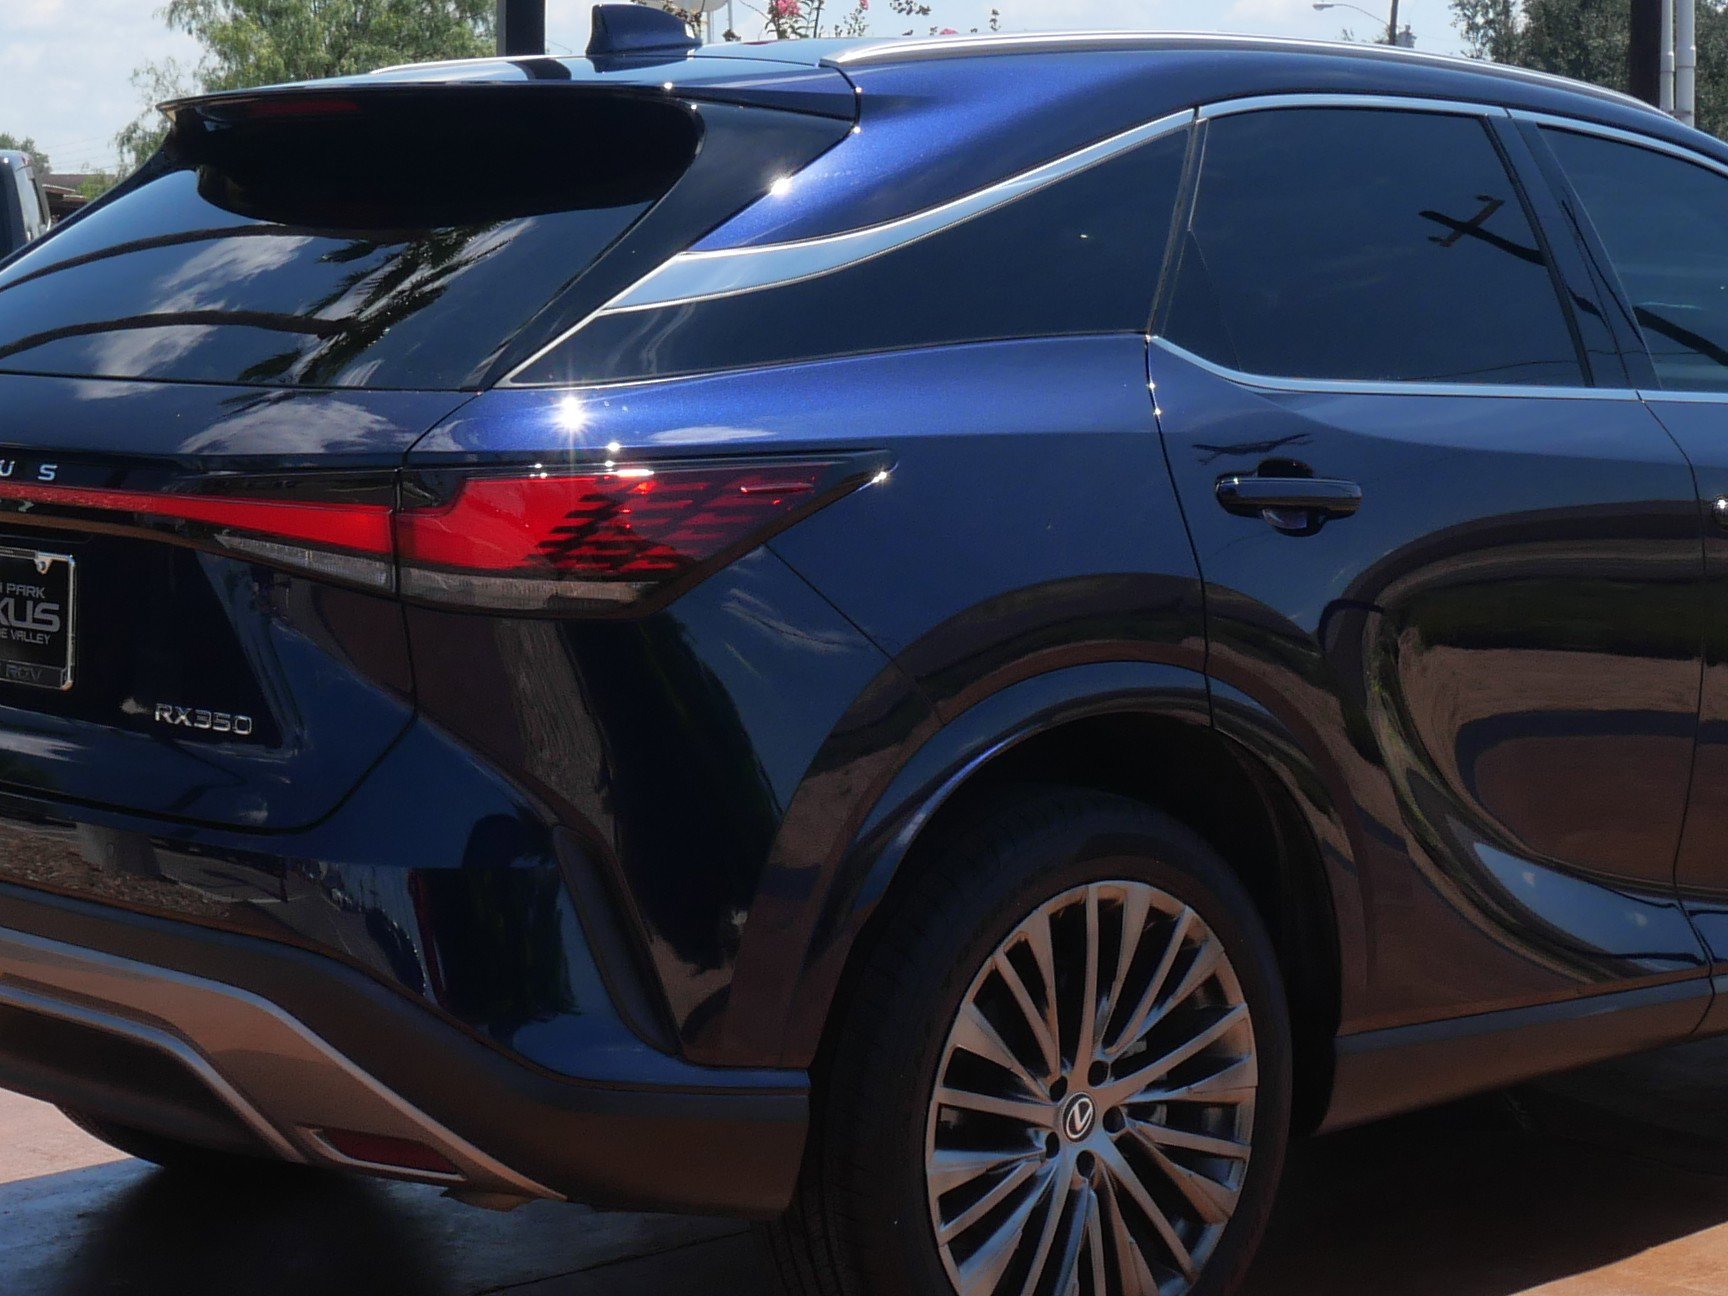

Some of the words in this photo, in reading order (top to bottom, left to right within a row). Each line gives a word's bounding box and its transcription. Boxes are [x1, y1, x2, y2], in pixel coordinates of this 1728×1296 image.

[6, 582, 47, 599] PARK
[10, 629, 52, 645] VALLEY
[155, 703, 252, 735] RX350
